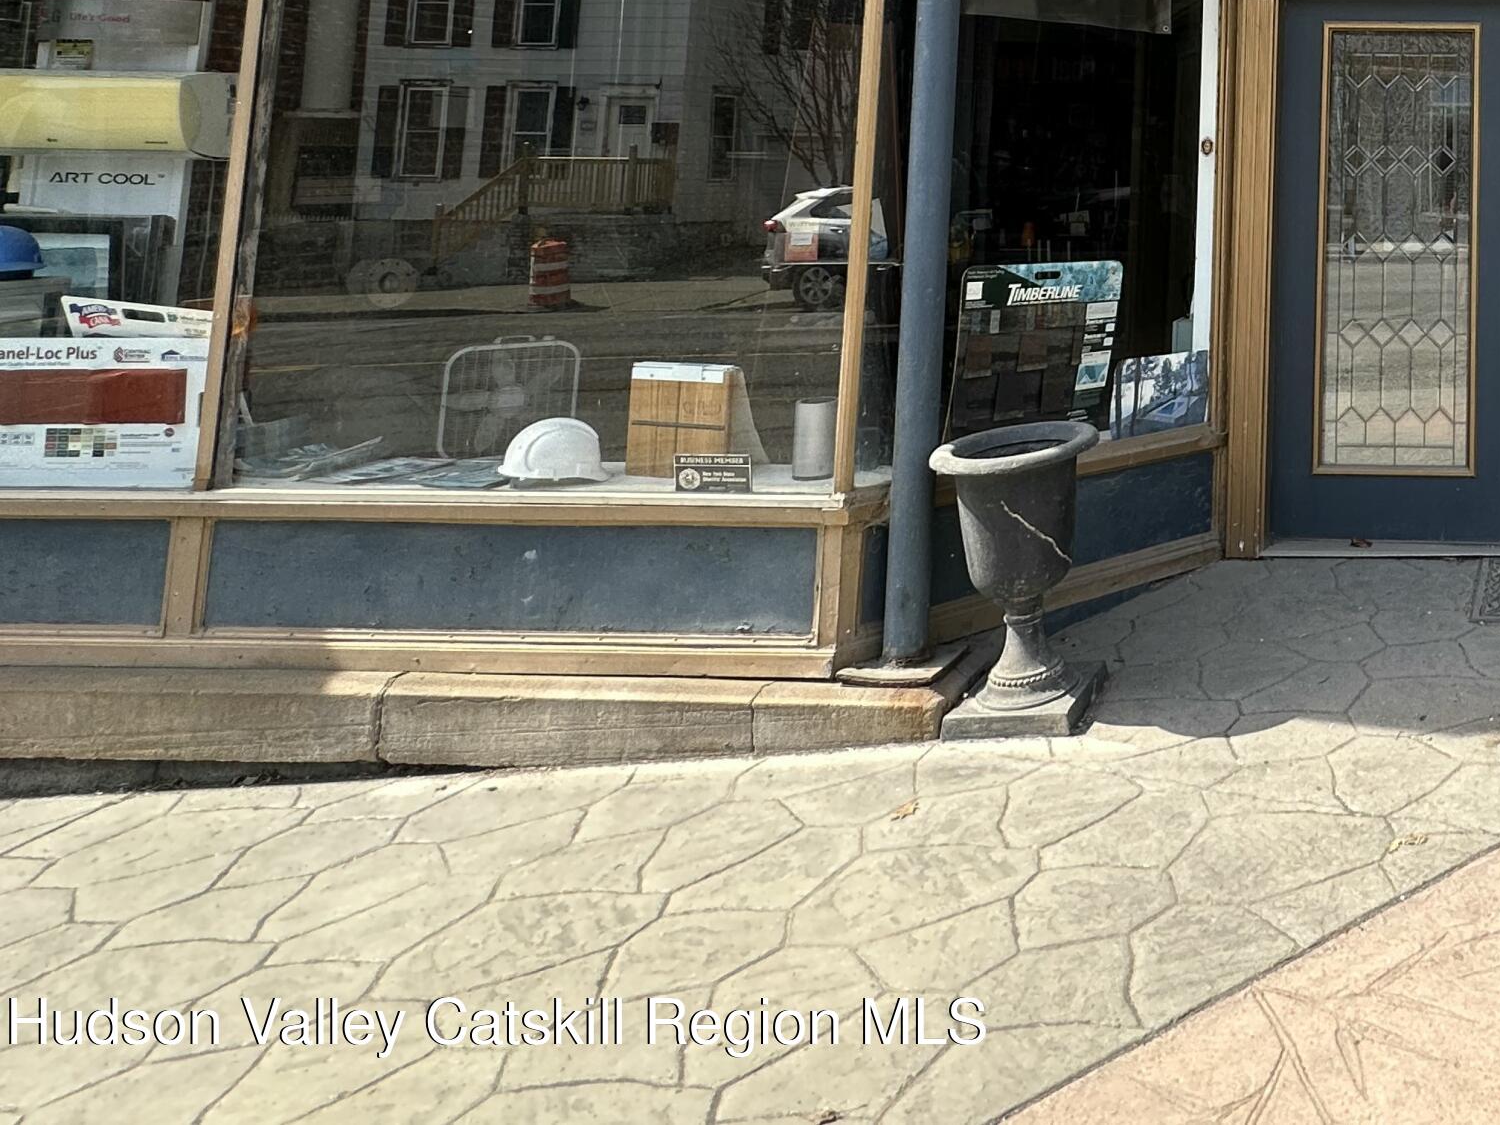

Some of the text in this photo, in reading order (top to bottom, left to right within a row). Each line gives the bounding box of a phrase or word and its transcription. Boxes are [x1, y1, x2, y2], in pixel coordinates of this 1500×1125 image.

[50, 172, 156, 185] ART COOL
[1006, 283, 1083, 306] TIMBERLINE
[66, 346, 98, 360] Plus
